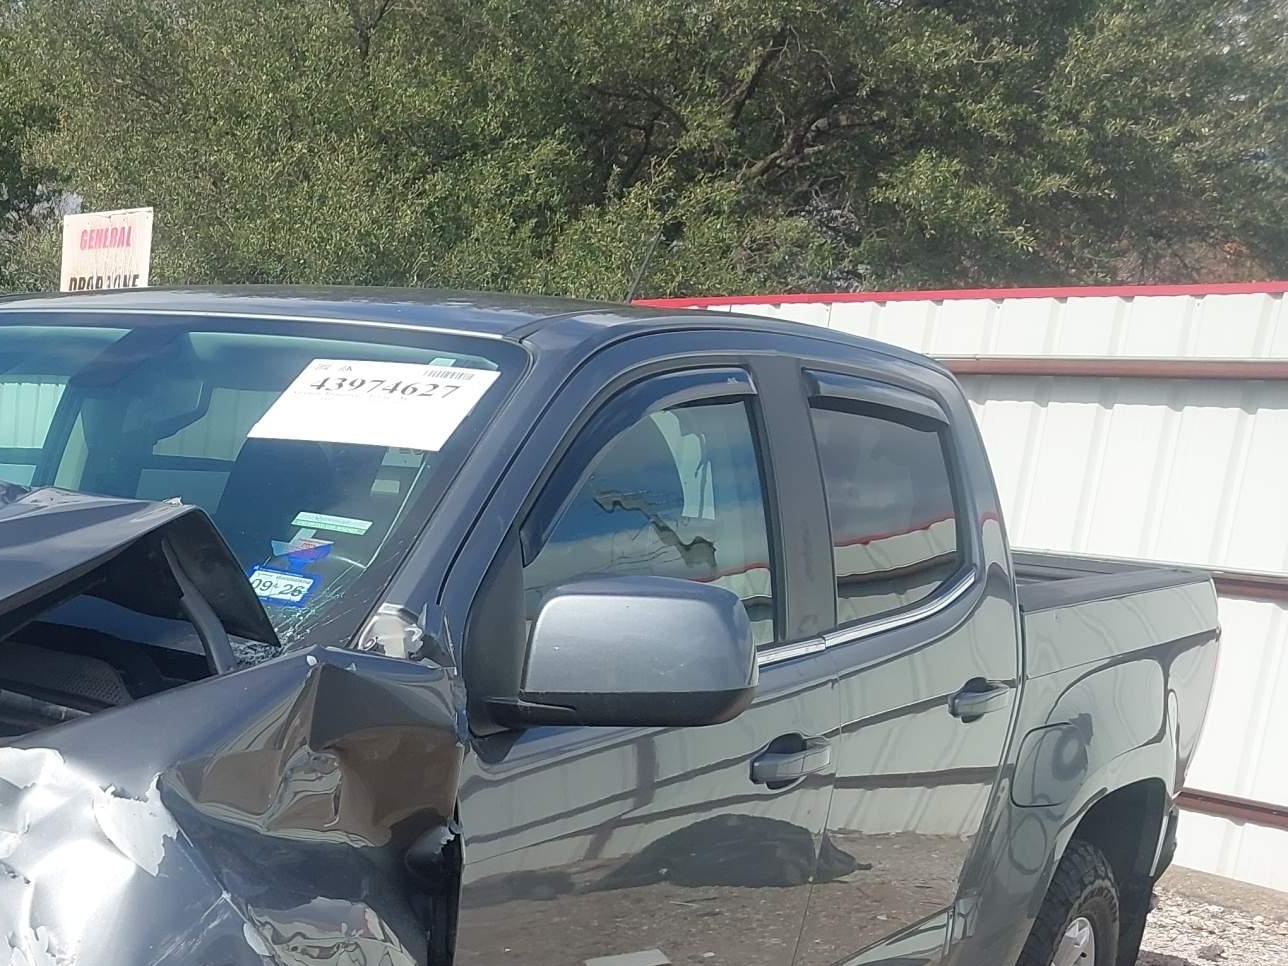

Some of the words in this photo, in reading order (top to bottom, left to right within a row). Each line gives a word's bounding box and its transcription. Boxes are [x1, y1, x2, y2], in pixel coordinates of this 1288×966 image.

[80, 226, 132, 251] GENERAL
[310, 376, 461, 399] 43974627
[250, 578, 273, 592] 09
